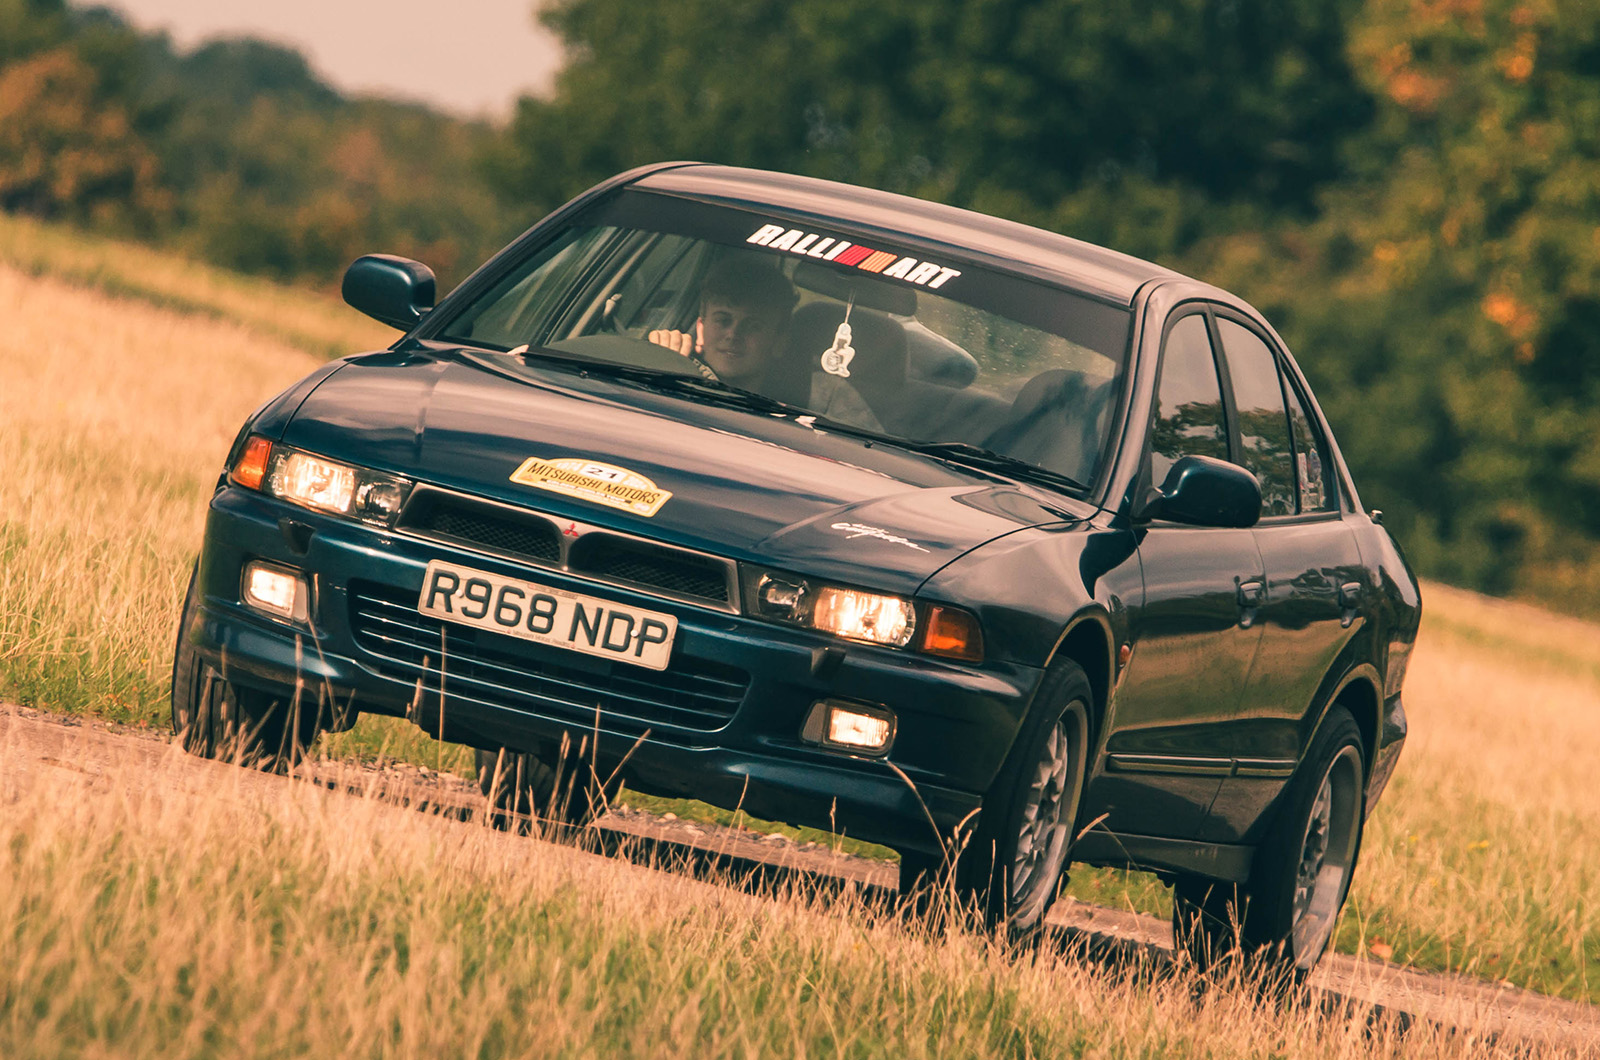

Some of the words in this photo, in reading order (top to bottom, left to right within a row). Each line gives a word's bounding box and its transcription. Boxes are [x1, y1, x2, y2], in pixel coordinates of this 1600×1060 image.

[526, 462, 601, 489] MITSUBISHI
[603, 483, 661, 504] MOTORS
[585, 466, 618, 480] 21
[425, 568, 558, 635] R968
[568, 602, 669, 658] NDP
